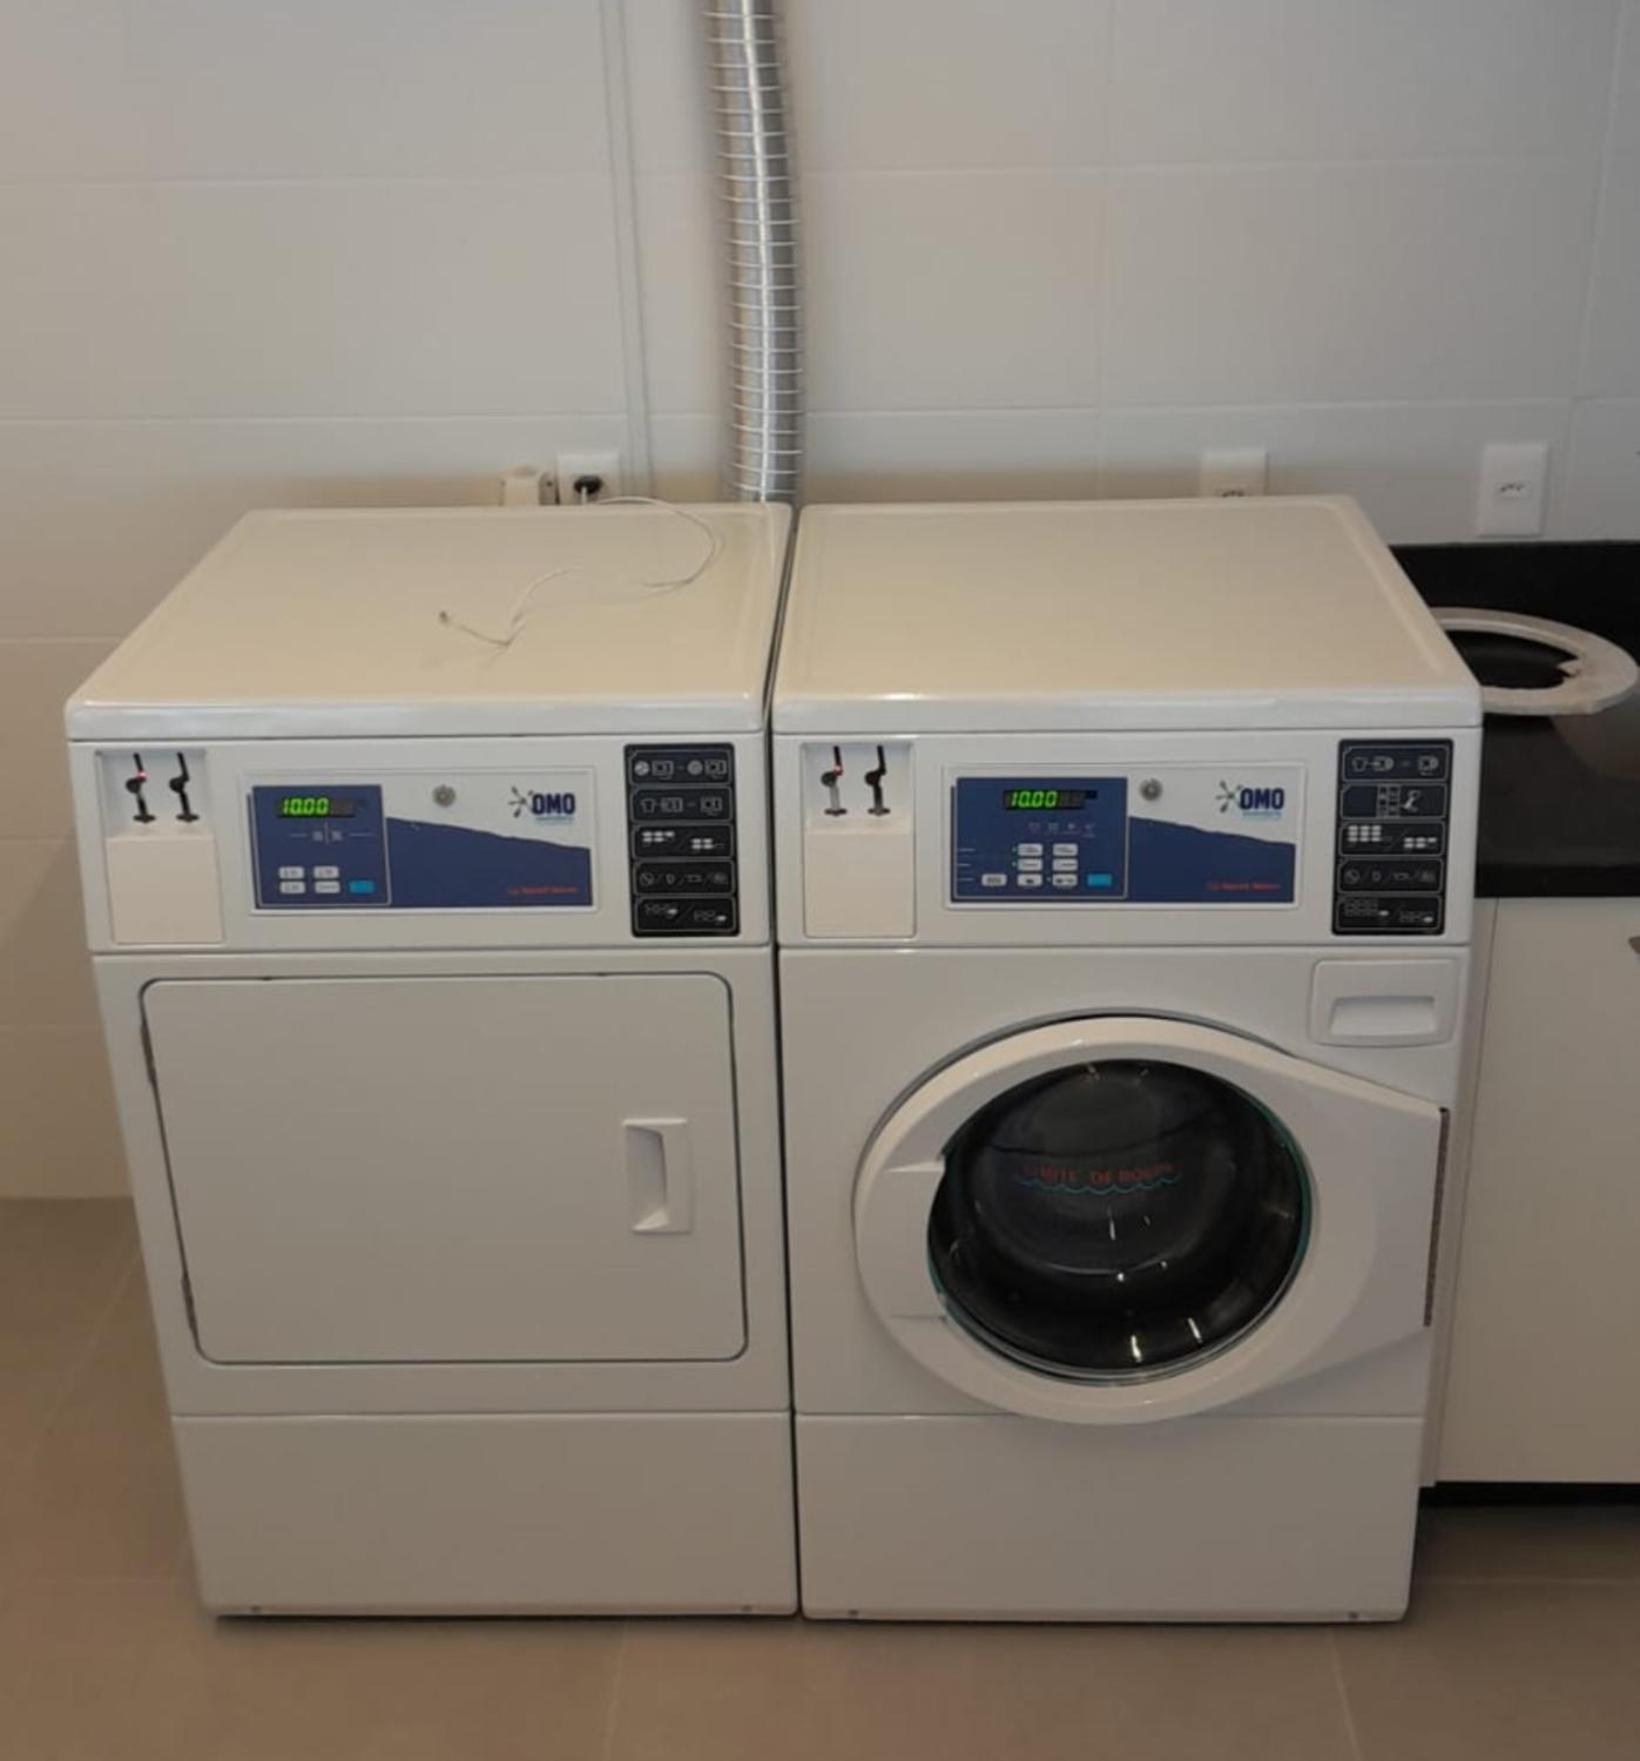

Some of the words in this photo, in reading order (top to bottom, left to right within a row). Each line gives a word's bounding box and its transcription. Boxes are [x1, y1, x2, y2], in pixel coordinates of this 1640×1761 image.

[283, 797, 329, 815] 10.00
[532, 792, 576, 814] OMO
[1011, 790, 1059, 808] 10.00
[1239, 787, 1285, 809] OMO
